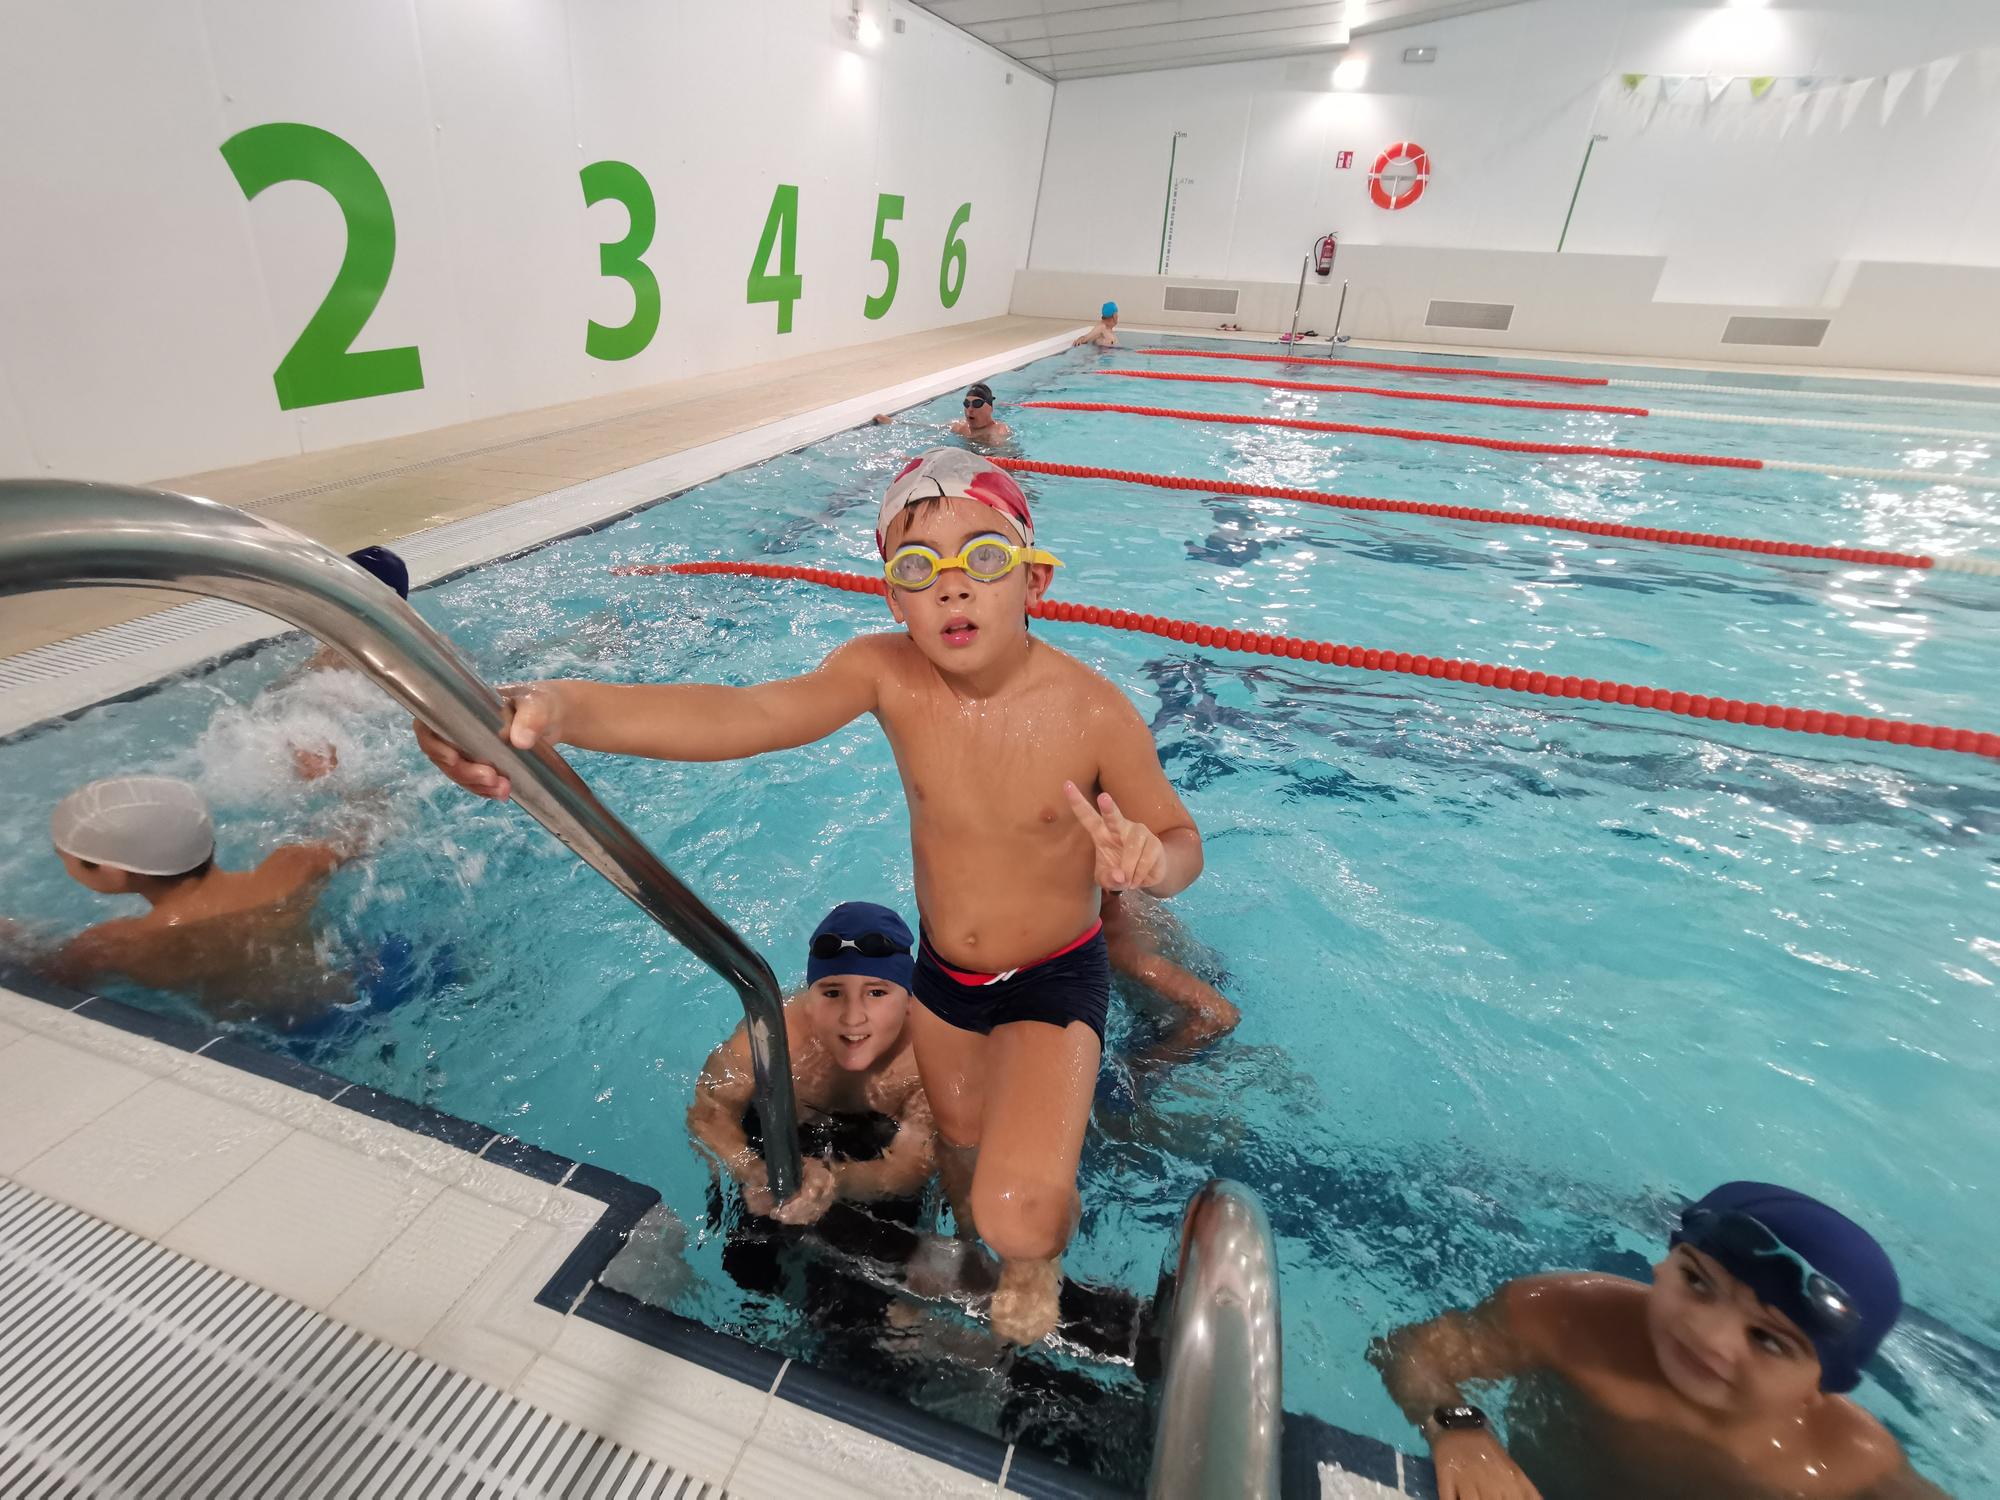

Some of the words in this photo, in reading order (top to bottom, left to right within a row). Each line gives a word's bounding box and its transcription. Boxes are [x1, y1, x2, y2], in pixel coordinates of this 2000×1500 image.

[220, 122, 423, 411] 2
[580, 161, 660, 360] 3
[747, 184, 802, 334] 4
[864, 194, 904, 320] 5
[940, 203, 971, 309] 6
